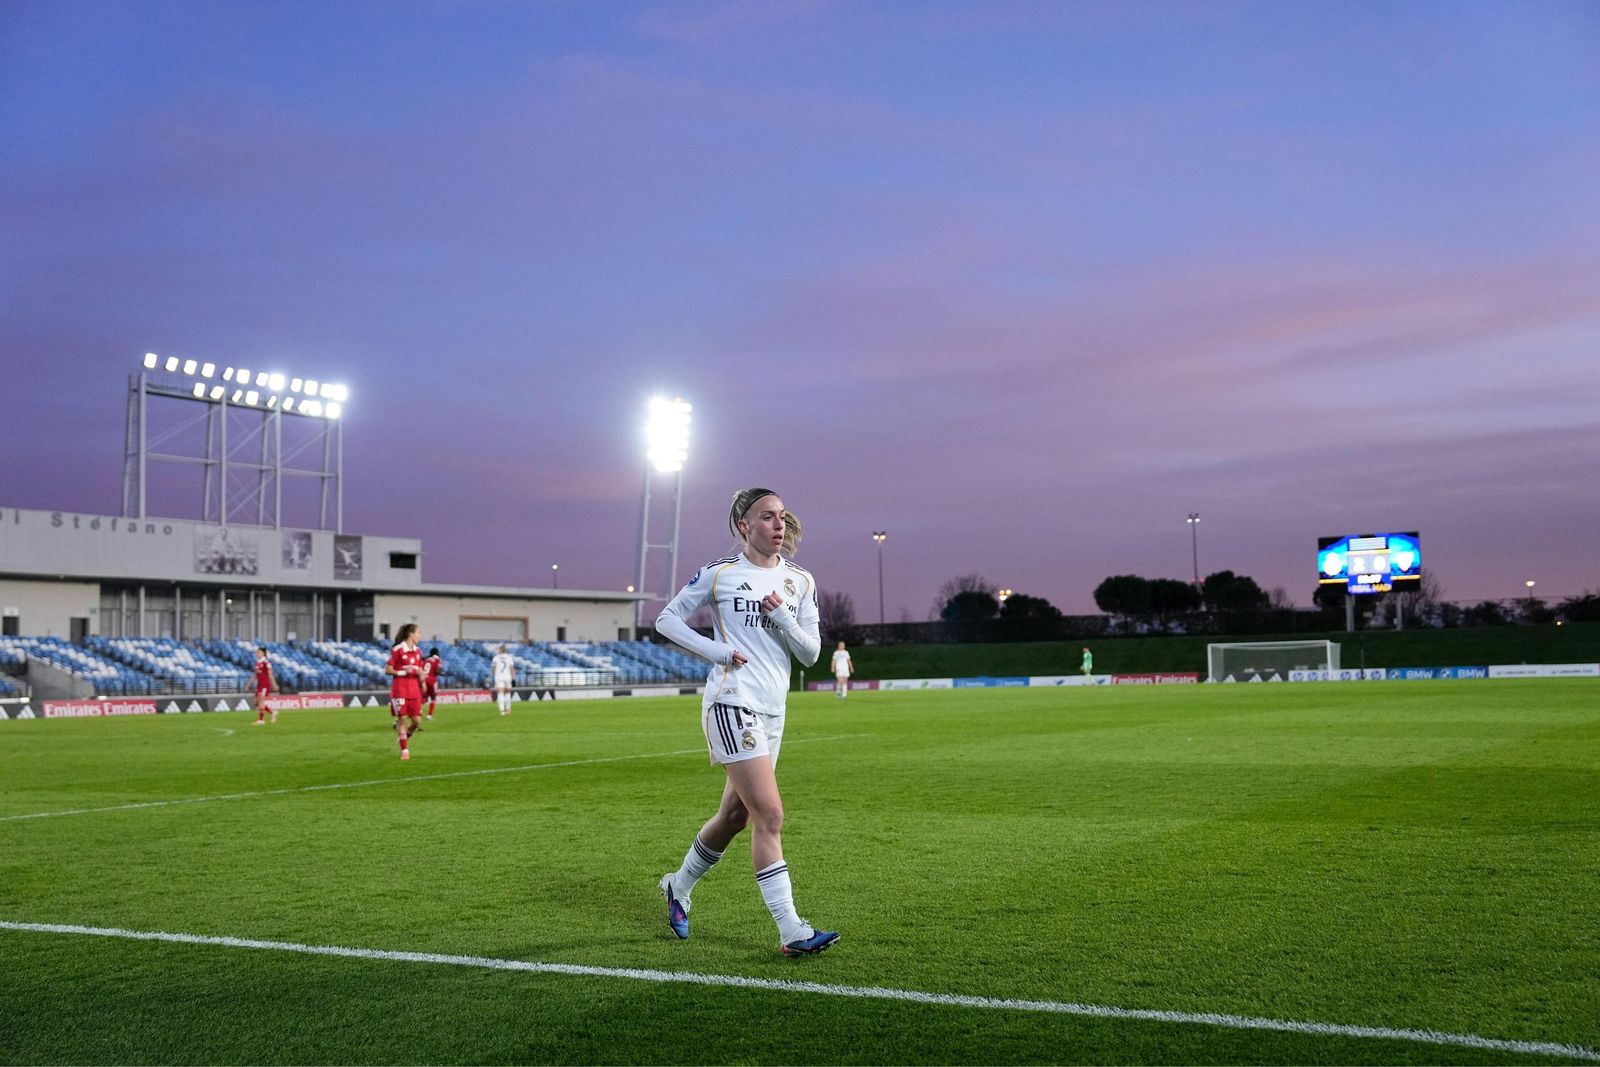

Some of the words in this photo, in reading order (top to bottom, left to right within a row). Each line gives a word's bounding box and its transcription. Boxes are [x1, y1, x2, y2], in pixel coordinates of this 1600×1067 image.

[1353, 557, 1365, 572] 2
[1373, 556, 1386, 571] 0
[745, 614, 761, 628] FLY
[500, 660, 507, 673] 7
[1113, 676, 1153, 685] Emirates
[1156, 675, 1197, 684] Emirates
[1406, 670, 1433, 679] BMW
[1457, 669, 1485, 678] BMW
[302, 696, 344, 709] Emirates
[458, 692, 492, 703] Emirates
[44, 703, 102, 718] Emirates
[103, 701, 156, 716] Emirates
